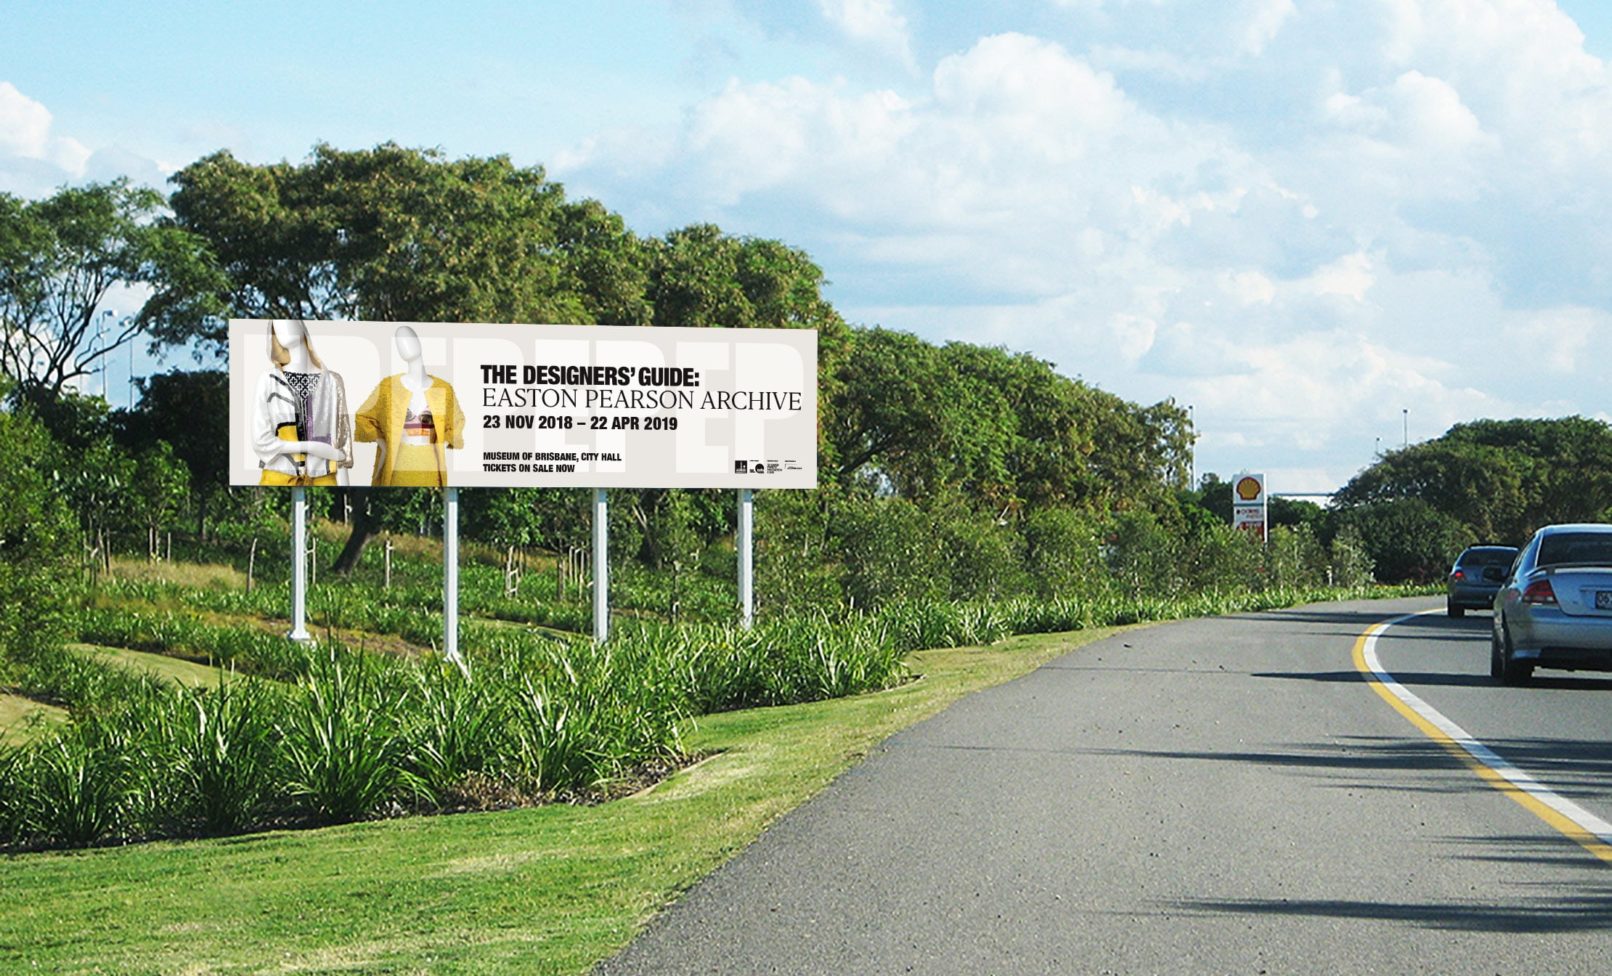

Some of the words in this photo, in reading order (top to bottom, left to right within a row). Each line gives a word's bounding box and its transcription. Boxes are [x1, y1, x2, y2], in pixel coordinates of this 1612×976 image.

[480, 364, 518, 385] THE
[637, 366, 700, 387] GUIDE:
[482, 387, 578, 408] EASTON
[585, 389, 694, 410] PEARSON
[699, 390, 802, 411] ARCHIVE
[482, 414, 501, 429] 23
[505, 414, 535, 430] NOV
[538, 415, 573, 430] 2018
[589, 415, 608, 430] 22
[610, 416, 640, 431] APR
[643, 416, 678, 431] 2019
[482, 451, 521, 461] MUSEUM
[521, 451, 533, 461] OF
[534, 451, 580, 463] BRISBANE,
[580, 452, 600, 462] CITY
[601, 452, 622, 462] HALL
[482, 463, 517, 473] TICKETS
[518, 463, 531, 473] ON
[532, 463, 554, 473] SALE
[555, 463, 576, 473] NOW
